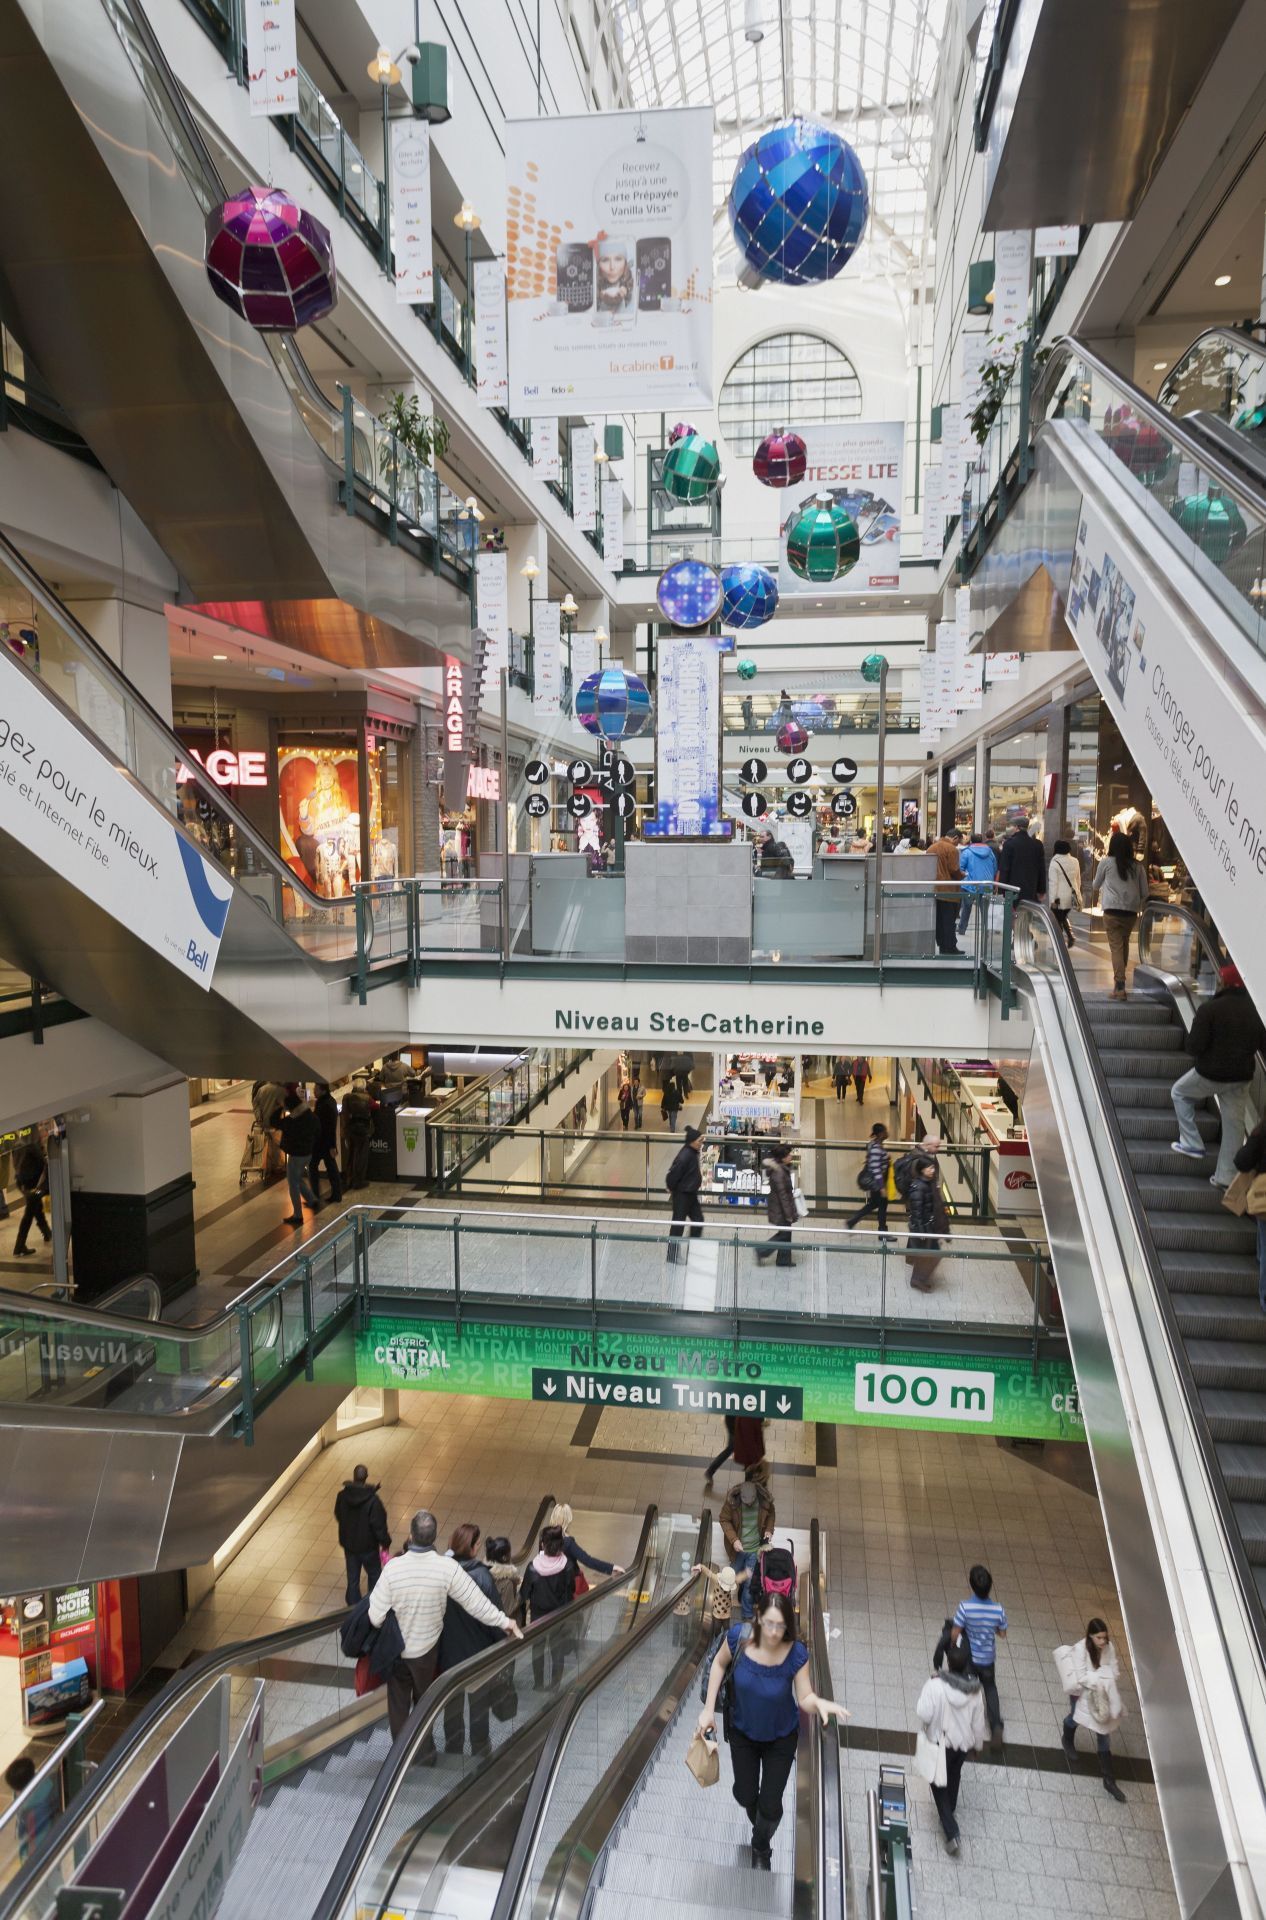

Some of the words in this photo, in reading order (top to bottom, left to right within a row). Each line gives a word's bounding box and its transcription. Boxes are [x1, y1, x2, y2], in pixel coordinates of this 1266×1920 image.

[622, 162, 661, 173] Recevez
[650, 176, 667, 186] une
[604, 192, 631, 203] Carte
[633, 189, 679, 202] Prépayée
[611, 205, 644, 216] Vanilla
[609, 360, 619, 374] la
[621, 359, 660, 373] cabine
[523, 385, 539, 396] Bell
[551, 385, 566, 394] fido
[868, 462, 898, 479] LTE
[739, 745, 770, 753] Niveau
[1151, 663, 1196, 755] Changez
[1192, 744, 1226, 800] pour
[1224, 781, 1239, 827] le
[1145, 705, 1164, 748] Passez
[1168, 748, 1183, 784] Télé
[1181, 777, 1190, 800] et
[1188, 790, 1219, 852] Internet
[1217, 839, 1237, 887] Fibe.
[18, 782, 35, 802] et
[34, 792, 86, 847] Internet
[84, 834, 111, 870] Fibe.
[36, 758, 88, 808] pour
[89, 796, 106, 828] le
[108, 820, 160, 880] mieux.
[186, 938, 209, 973] Bell
[555, 1009, 640, 1032] Niveau
[649, 1011, 825, 1036] Ste-Catherine
[717, 1167, 733, 1180] Bell
[1007, 1171, 1027, 1188] Virgin
[466, 1324, 481, 1336] LE
[484, 1325, 532, 1339] CENTRE
[535, 1328, 575, 1341] EATON
[578, 1330, 593, 1342] DE
[390, 1337, 431, 1348] DISTRICT
[597, 1331, 624, 1354] 32
[626, 1333, 660, 1345] RESTOS
[670, 1337, 681, 1346] LE
[684, 1338, 720, 1348] CENTRE
[755, 1342, 769, 1351] DE
[374, 1346, 451, 1369] CENTRAL
[570, 1345, 667, 1373] Niveau
[676, 1350, 762, 1378] Métro
[391, 1365, 431, 1377] DISTRICT
[454, 1360, 485, 1386] 32
[566, 1375, 661, 1405] Niveau
[672, 1384, 766, 1413] Tunnel
[863, 1372, 938, 1407] 100
[950, 1385, 986, 1411] m
[56, 1587, 90, 1604] VENDREDI
[56, 1595, 90, 1615] NOIR
[57, 1606, 90, 1622] canadien
